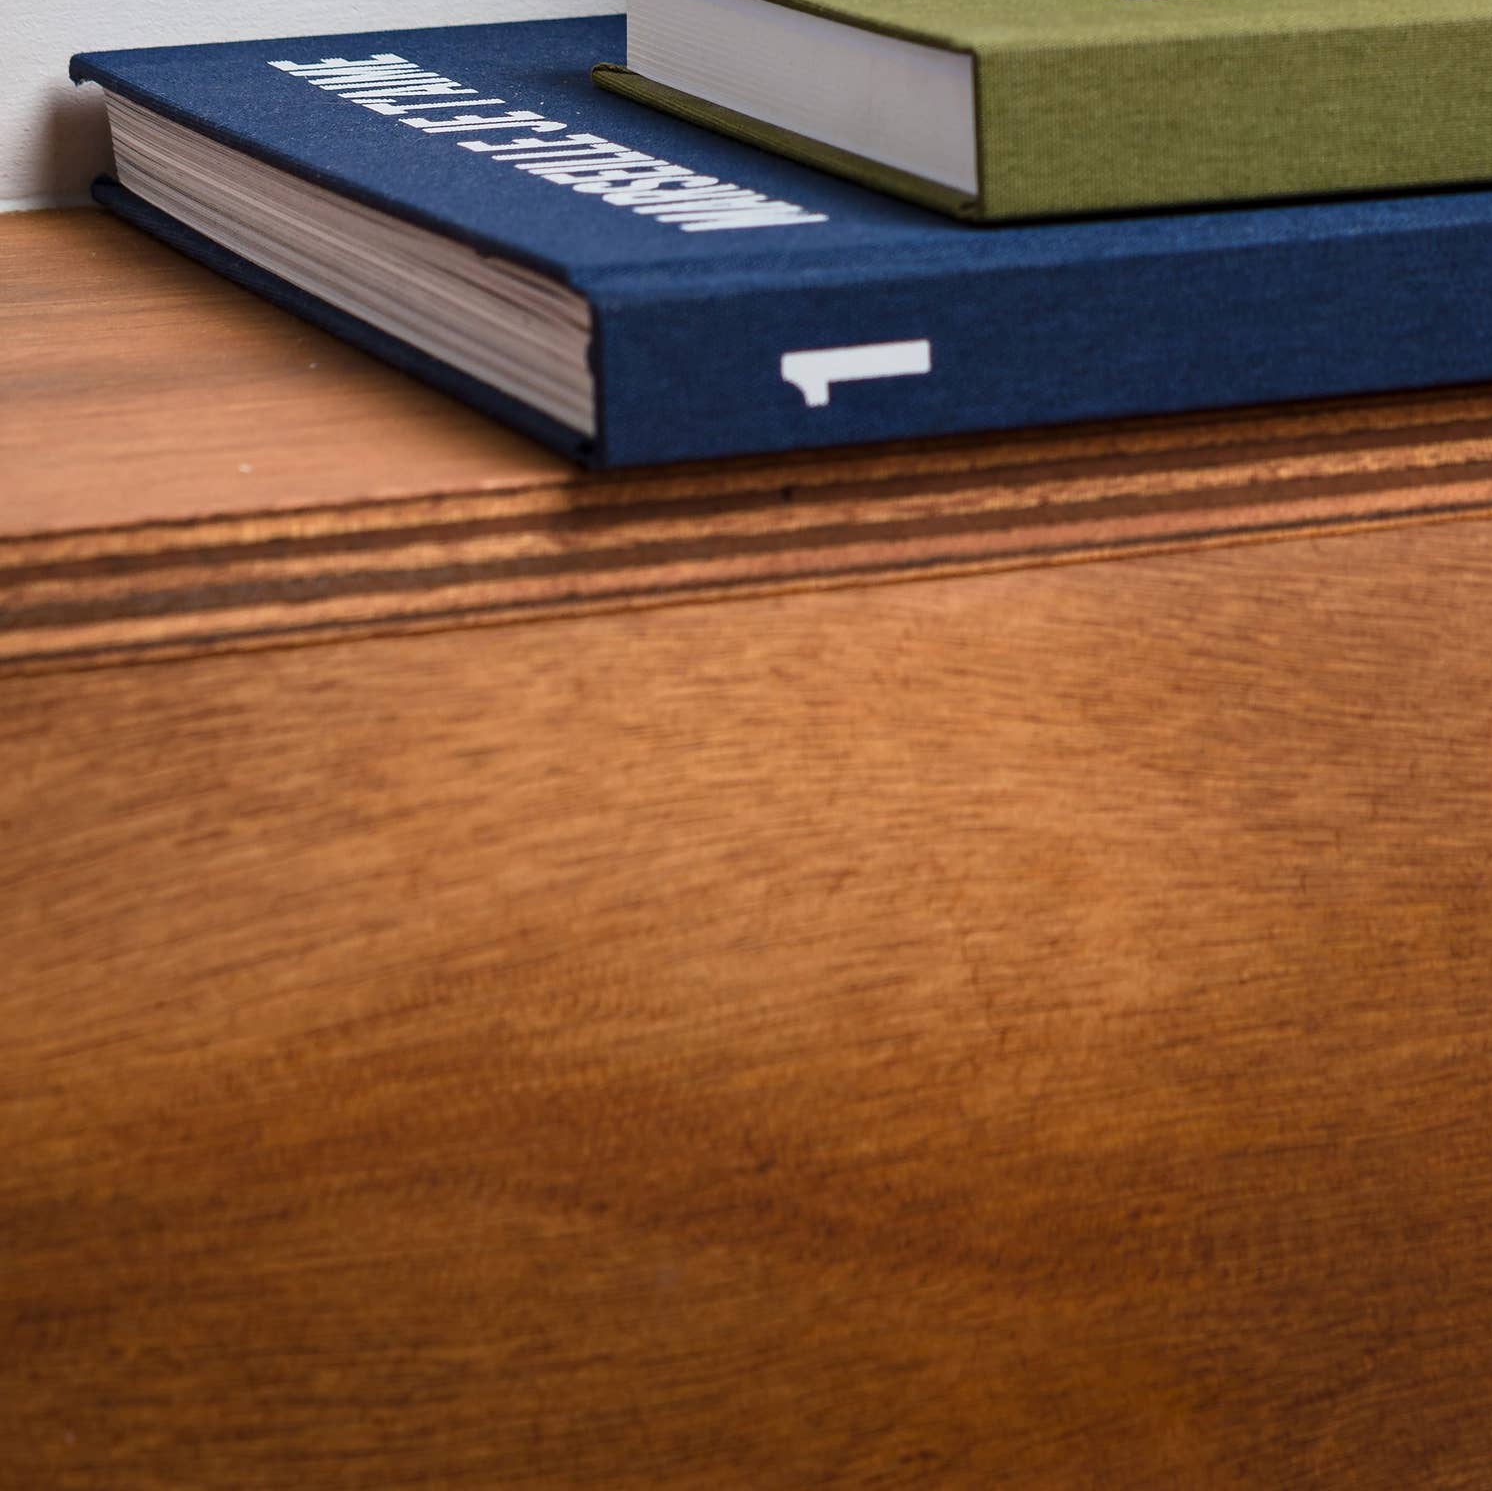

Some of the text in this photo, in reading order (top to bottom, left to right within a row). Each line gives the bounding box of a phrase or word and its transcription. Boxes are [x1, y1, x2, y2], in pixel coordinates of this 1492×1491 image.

[267, 52, 829, 232] MARSEILLE JE T'AIME
